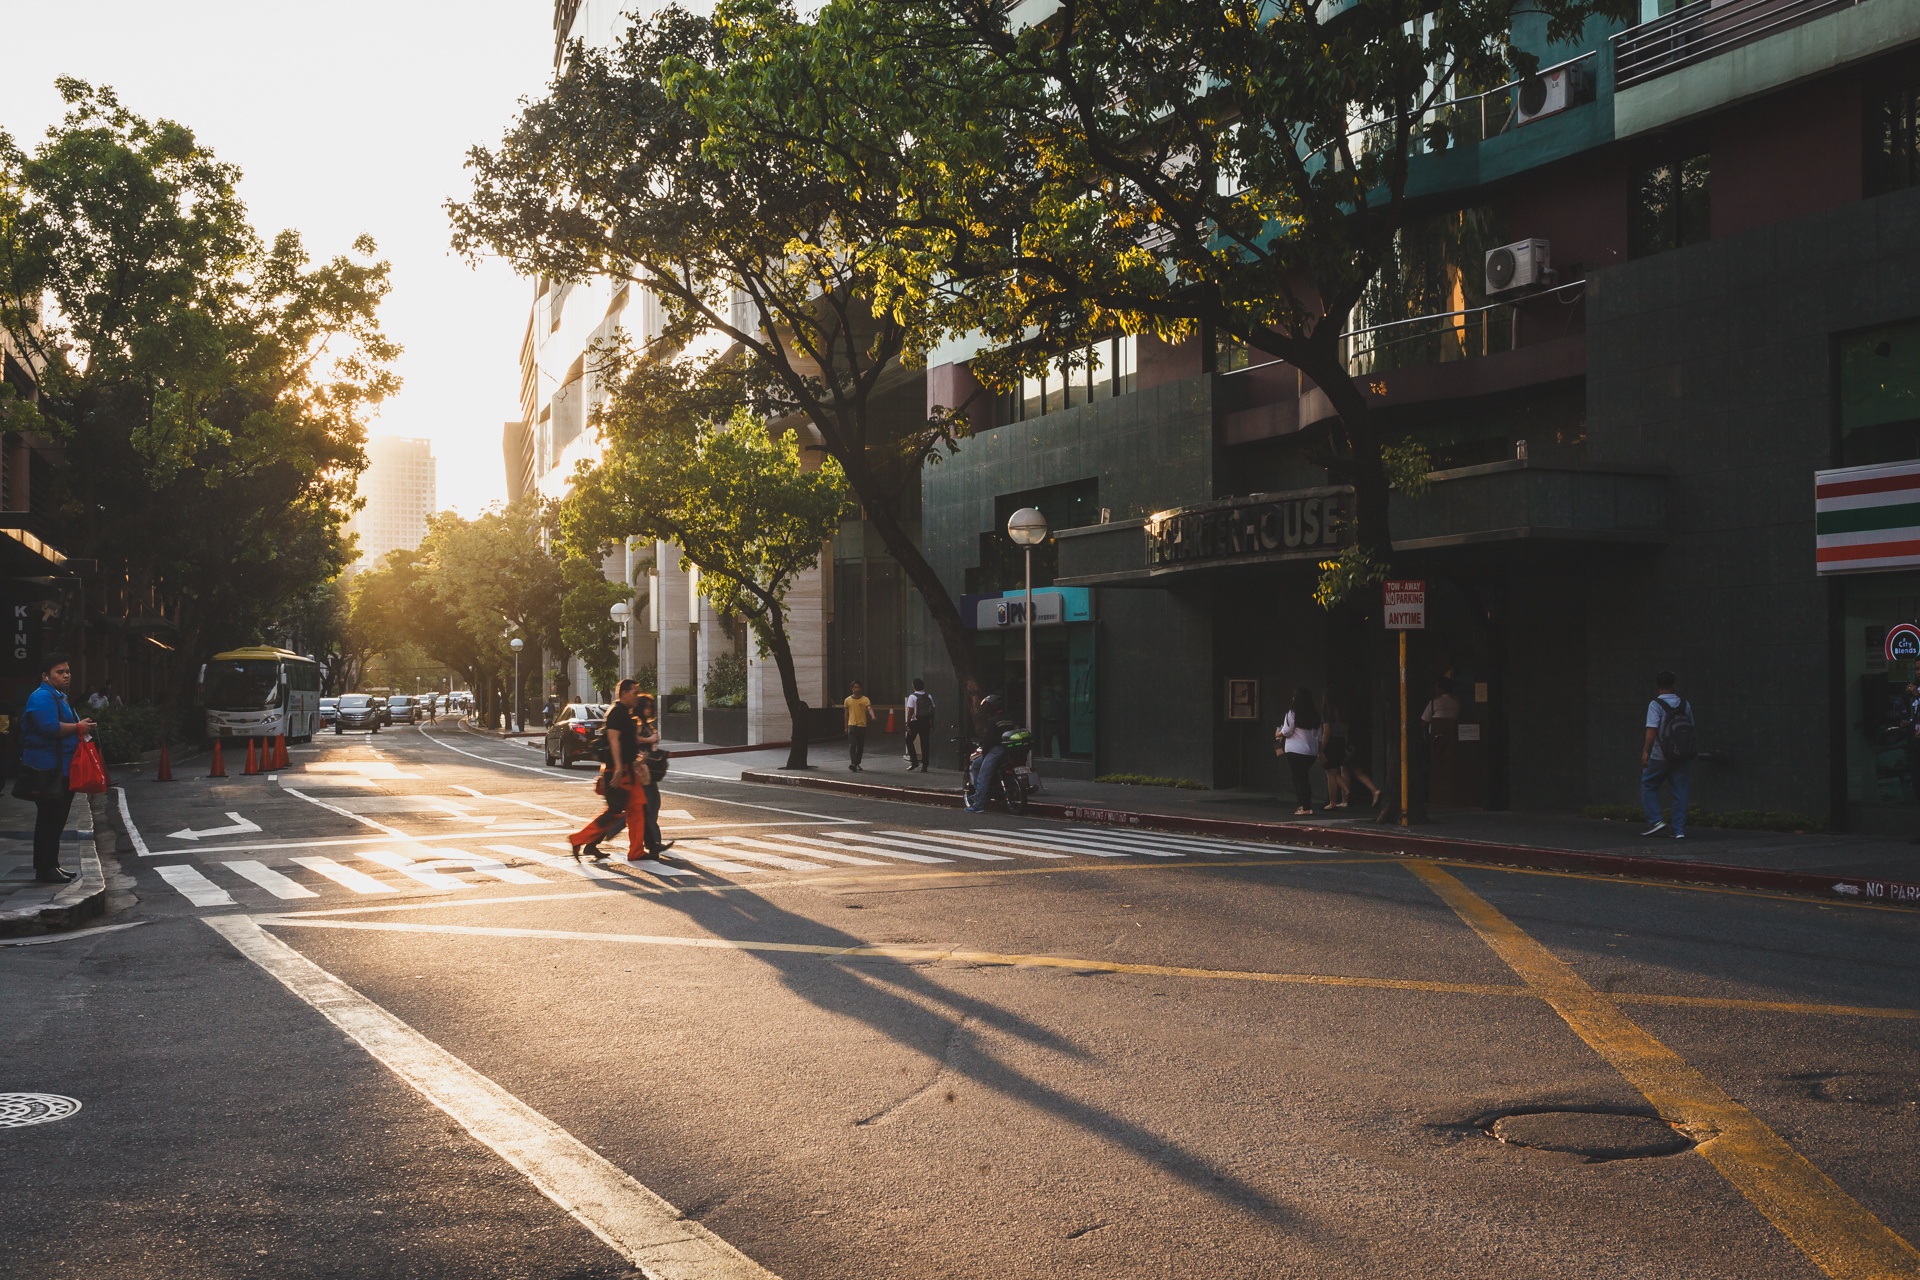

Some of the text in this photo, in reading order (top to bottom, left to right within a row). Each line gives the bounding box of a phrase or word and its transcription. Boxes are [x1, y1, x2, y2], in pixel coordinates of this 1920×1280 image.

[1162, 498, 1338, 561] CHARTERHOUSE
[1385, 592, 1423, 604] NO PARKING
[1010, 601, 1037, 623] PNB
[1389, 613, 1421, 624] ANYTIME
[14, 605, 28, 659] KING
[1898, 638, 1912, 648] City
[1866, 882, 1884, 897] NO
